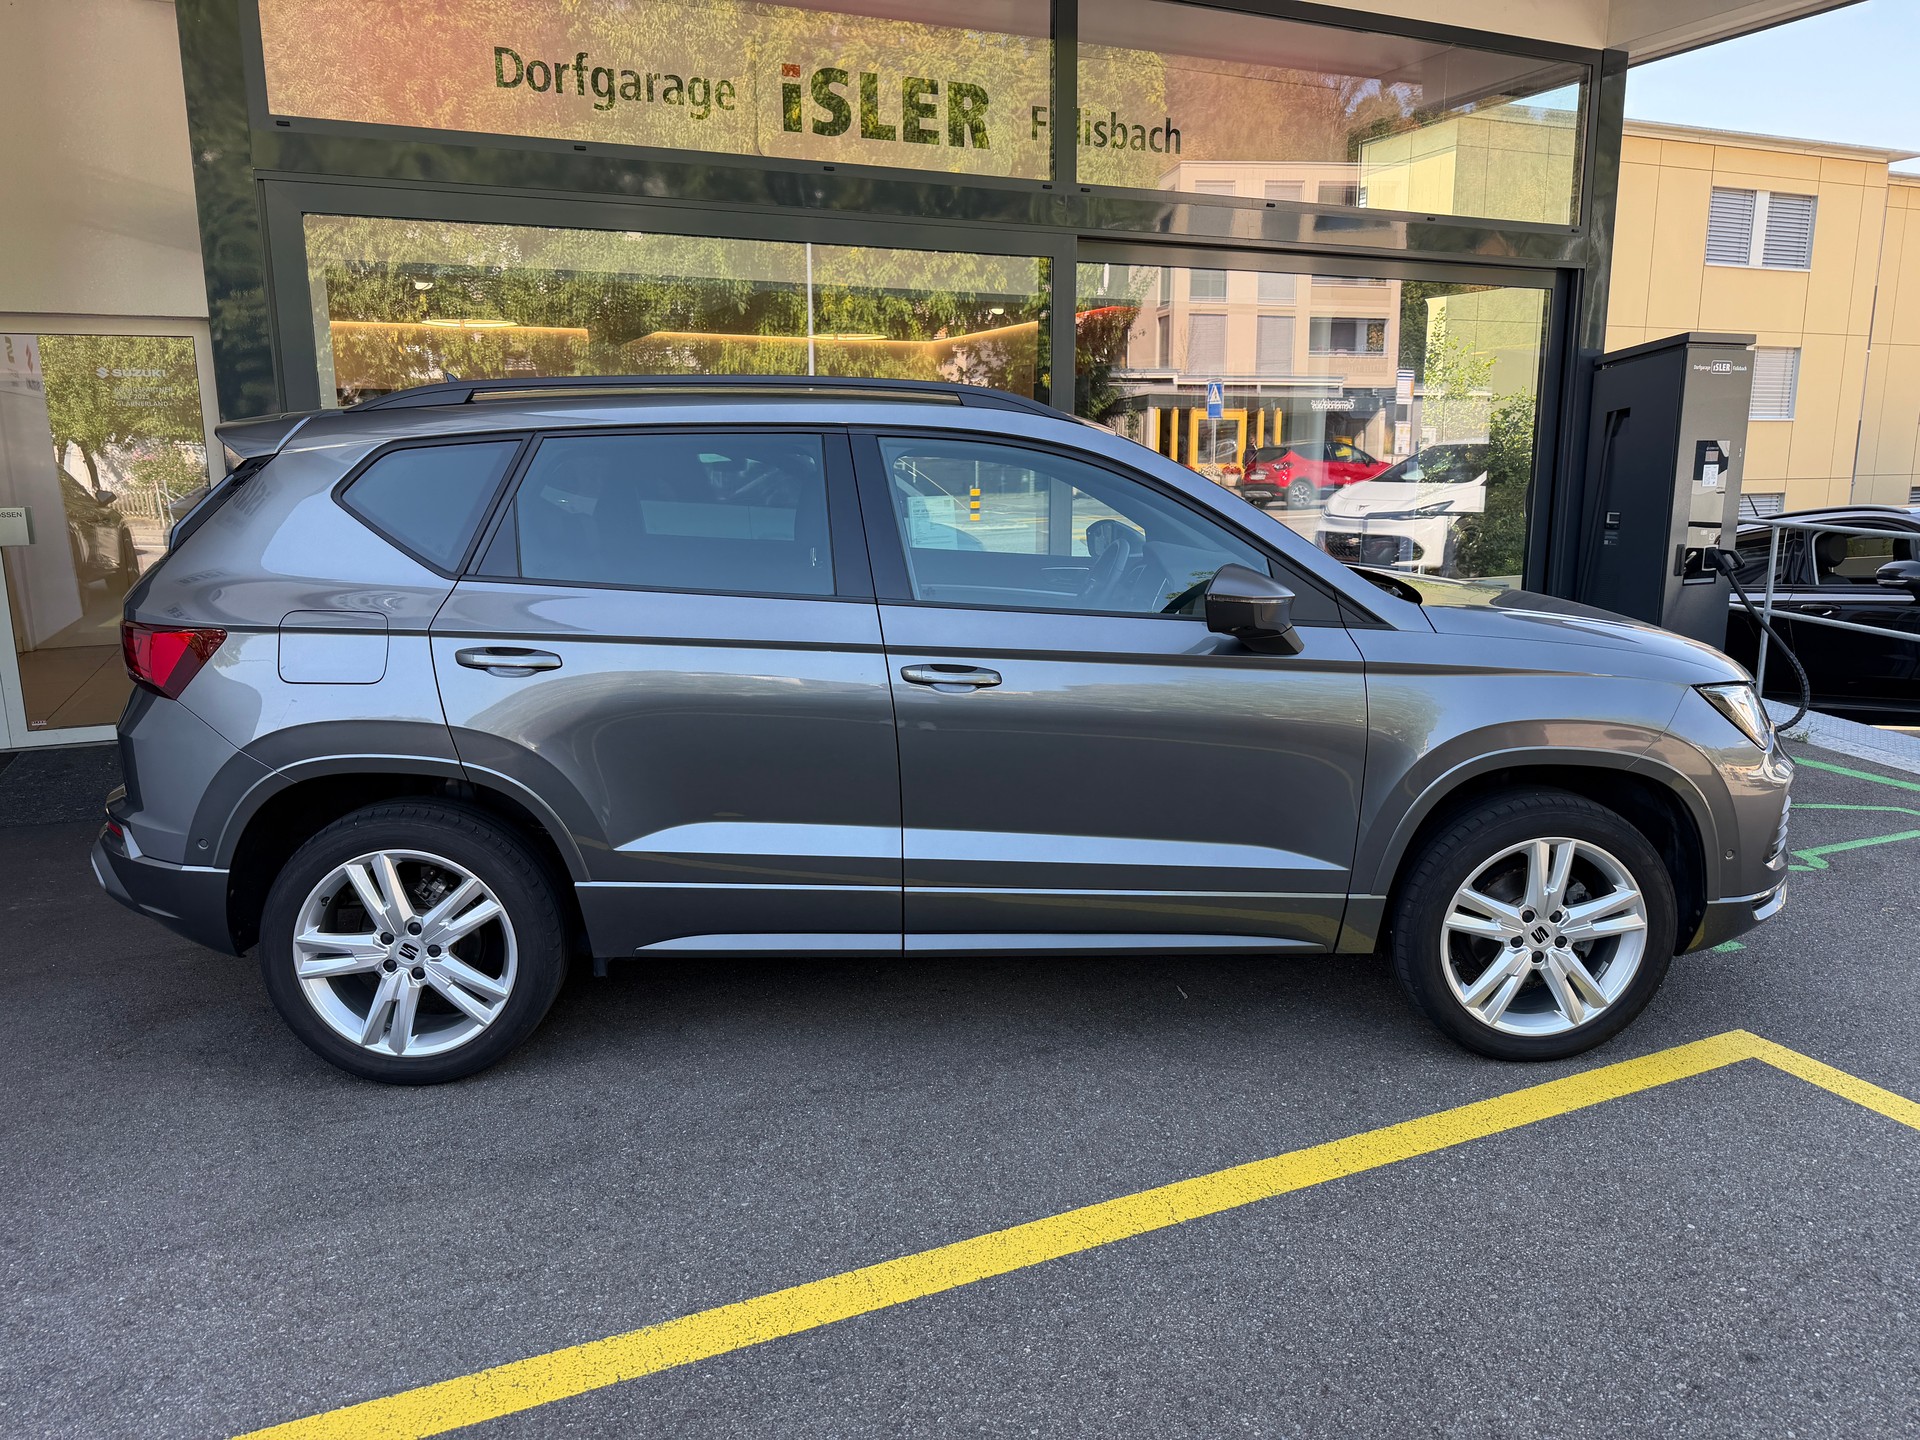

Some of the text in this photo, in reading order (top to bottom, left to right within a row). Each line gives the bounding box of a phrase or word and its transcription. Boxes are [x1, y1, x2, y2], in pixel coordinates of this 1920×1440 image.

[493, 46, 1181, 154] Dorfgarage iSLER Flisbach
[1712, 363, 1731, 372] iSLER
[111, 368, 166, 378] SUZUKI
